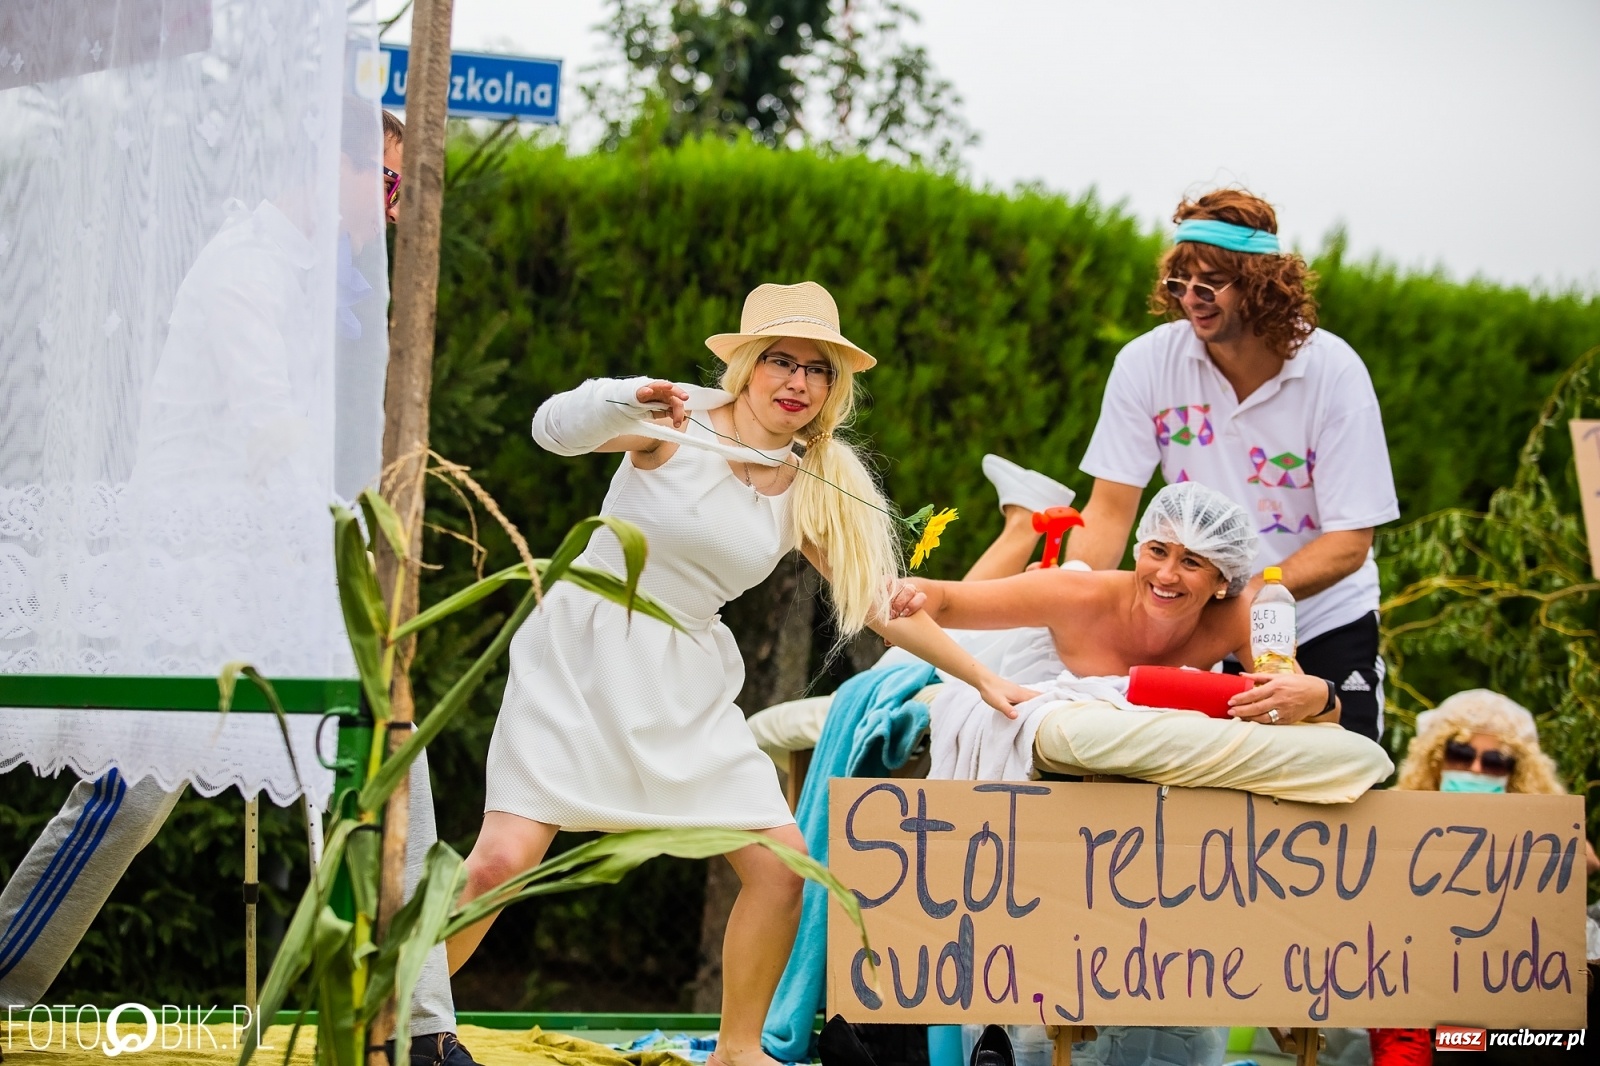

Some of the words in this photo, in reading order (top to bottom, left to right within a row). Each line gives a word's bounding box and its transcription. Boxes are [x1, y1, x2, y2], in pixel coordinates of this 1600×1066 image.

[446, 66, 553, 108] zkolna
[1252, 609, 1277, 625] OLEJ
[1079, 786, 1377, 909] relaksu
[1409, 823, 1582, 938] czyni
[1055, 917, 1263, 1022] jedrne
[1284, 920, 1412, 1022] cycki
[1450, 936, 1463, 994] i
[1483, 915, 1572, 994] uda
